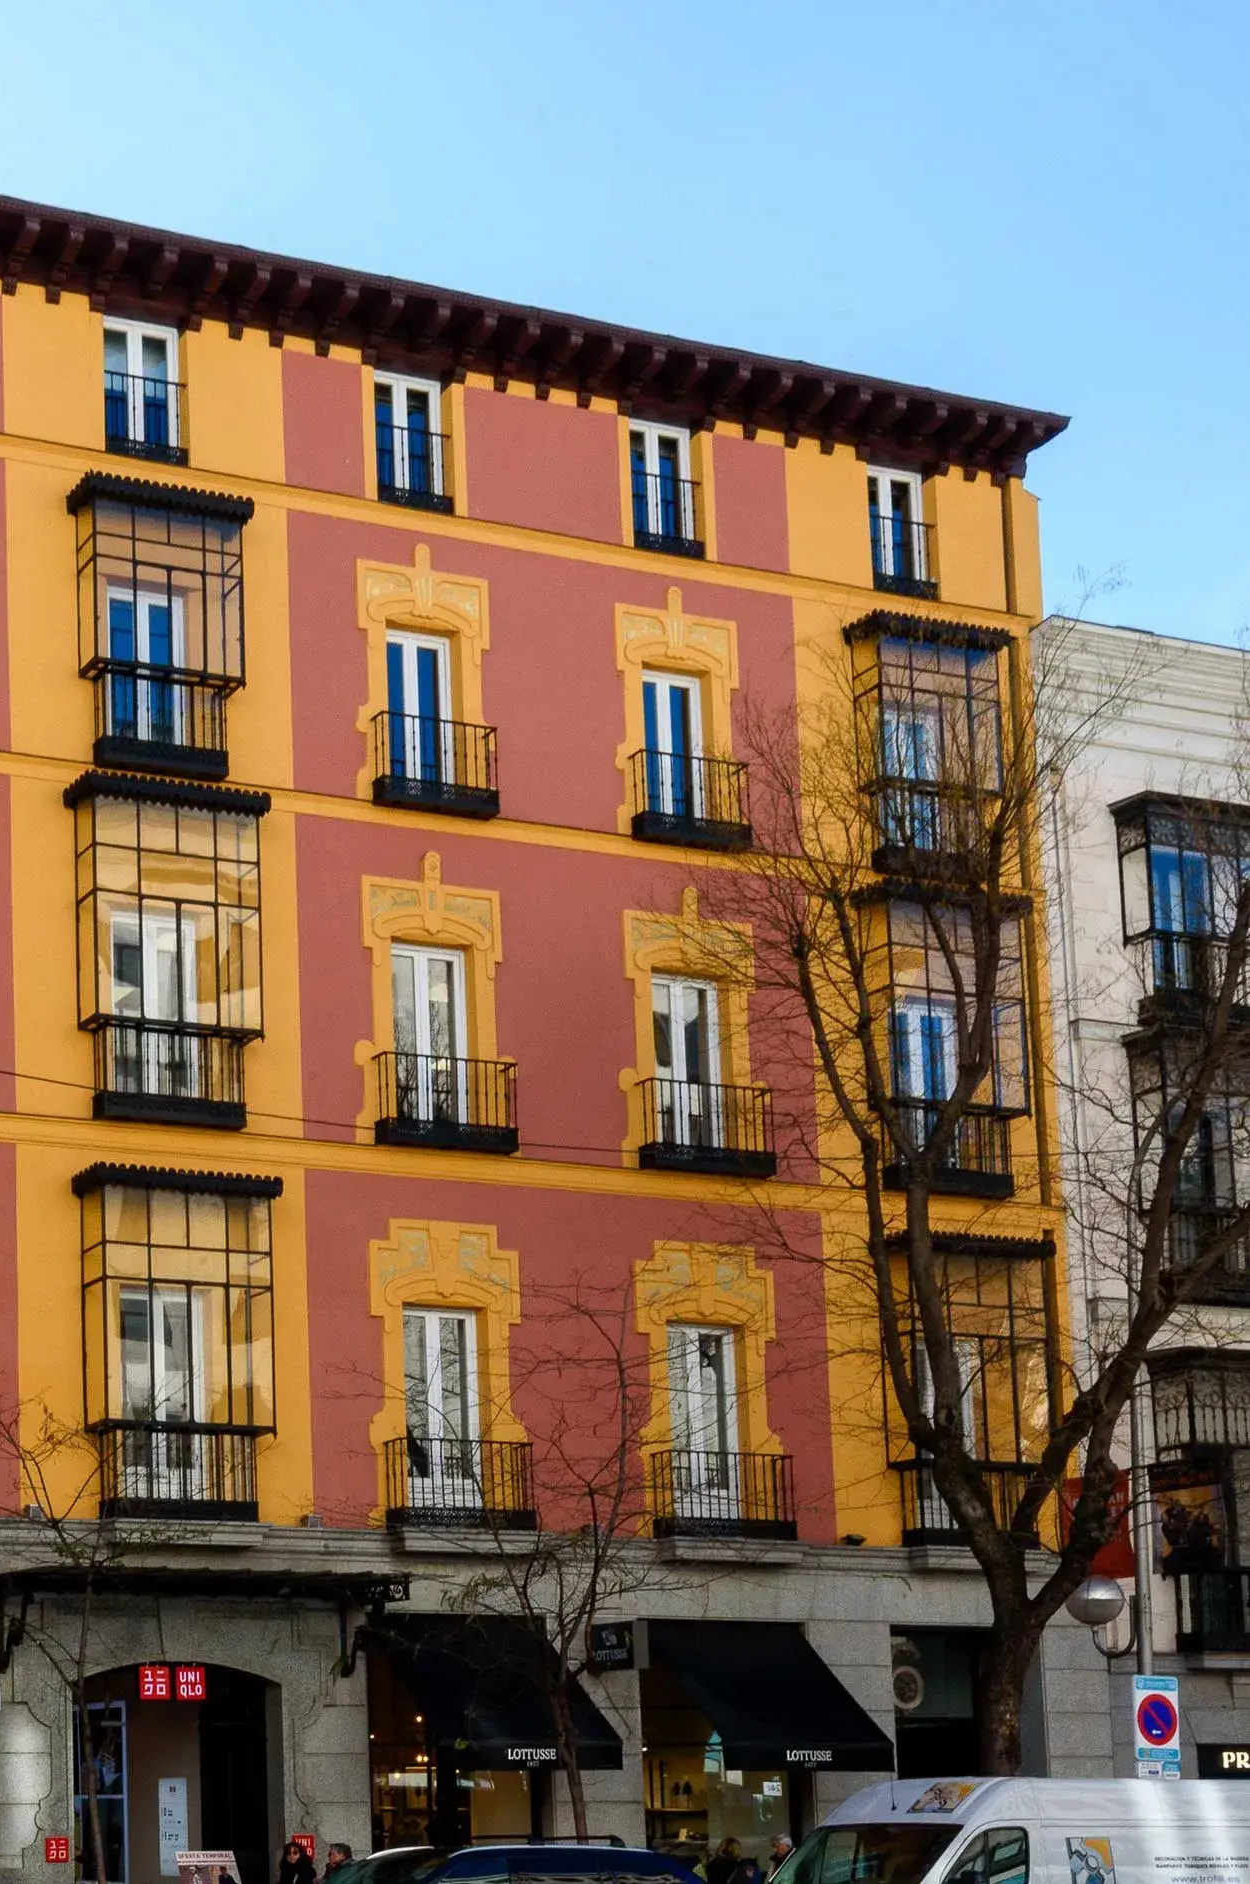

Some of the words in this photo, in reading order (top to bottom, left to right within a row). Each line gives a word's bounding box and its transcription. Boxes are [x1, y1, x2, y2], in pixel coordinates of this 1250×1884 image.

[179, 1671, 200, 1683] UNI
[180, 1684, 202, 1699] QLO
[507, 1748, 557, 1760] LOTTUSSE
[786, 1749, 833, 1761] LOTTUSSE
[1222, 1751, 1250, 1769] PR
